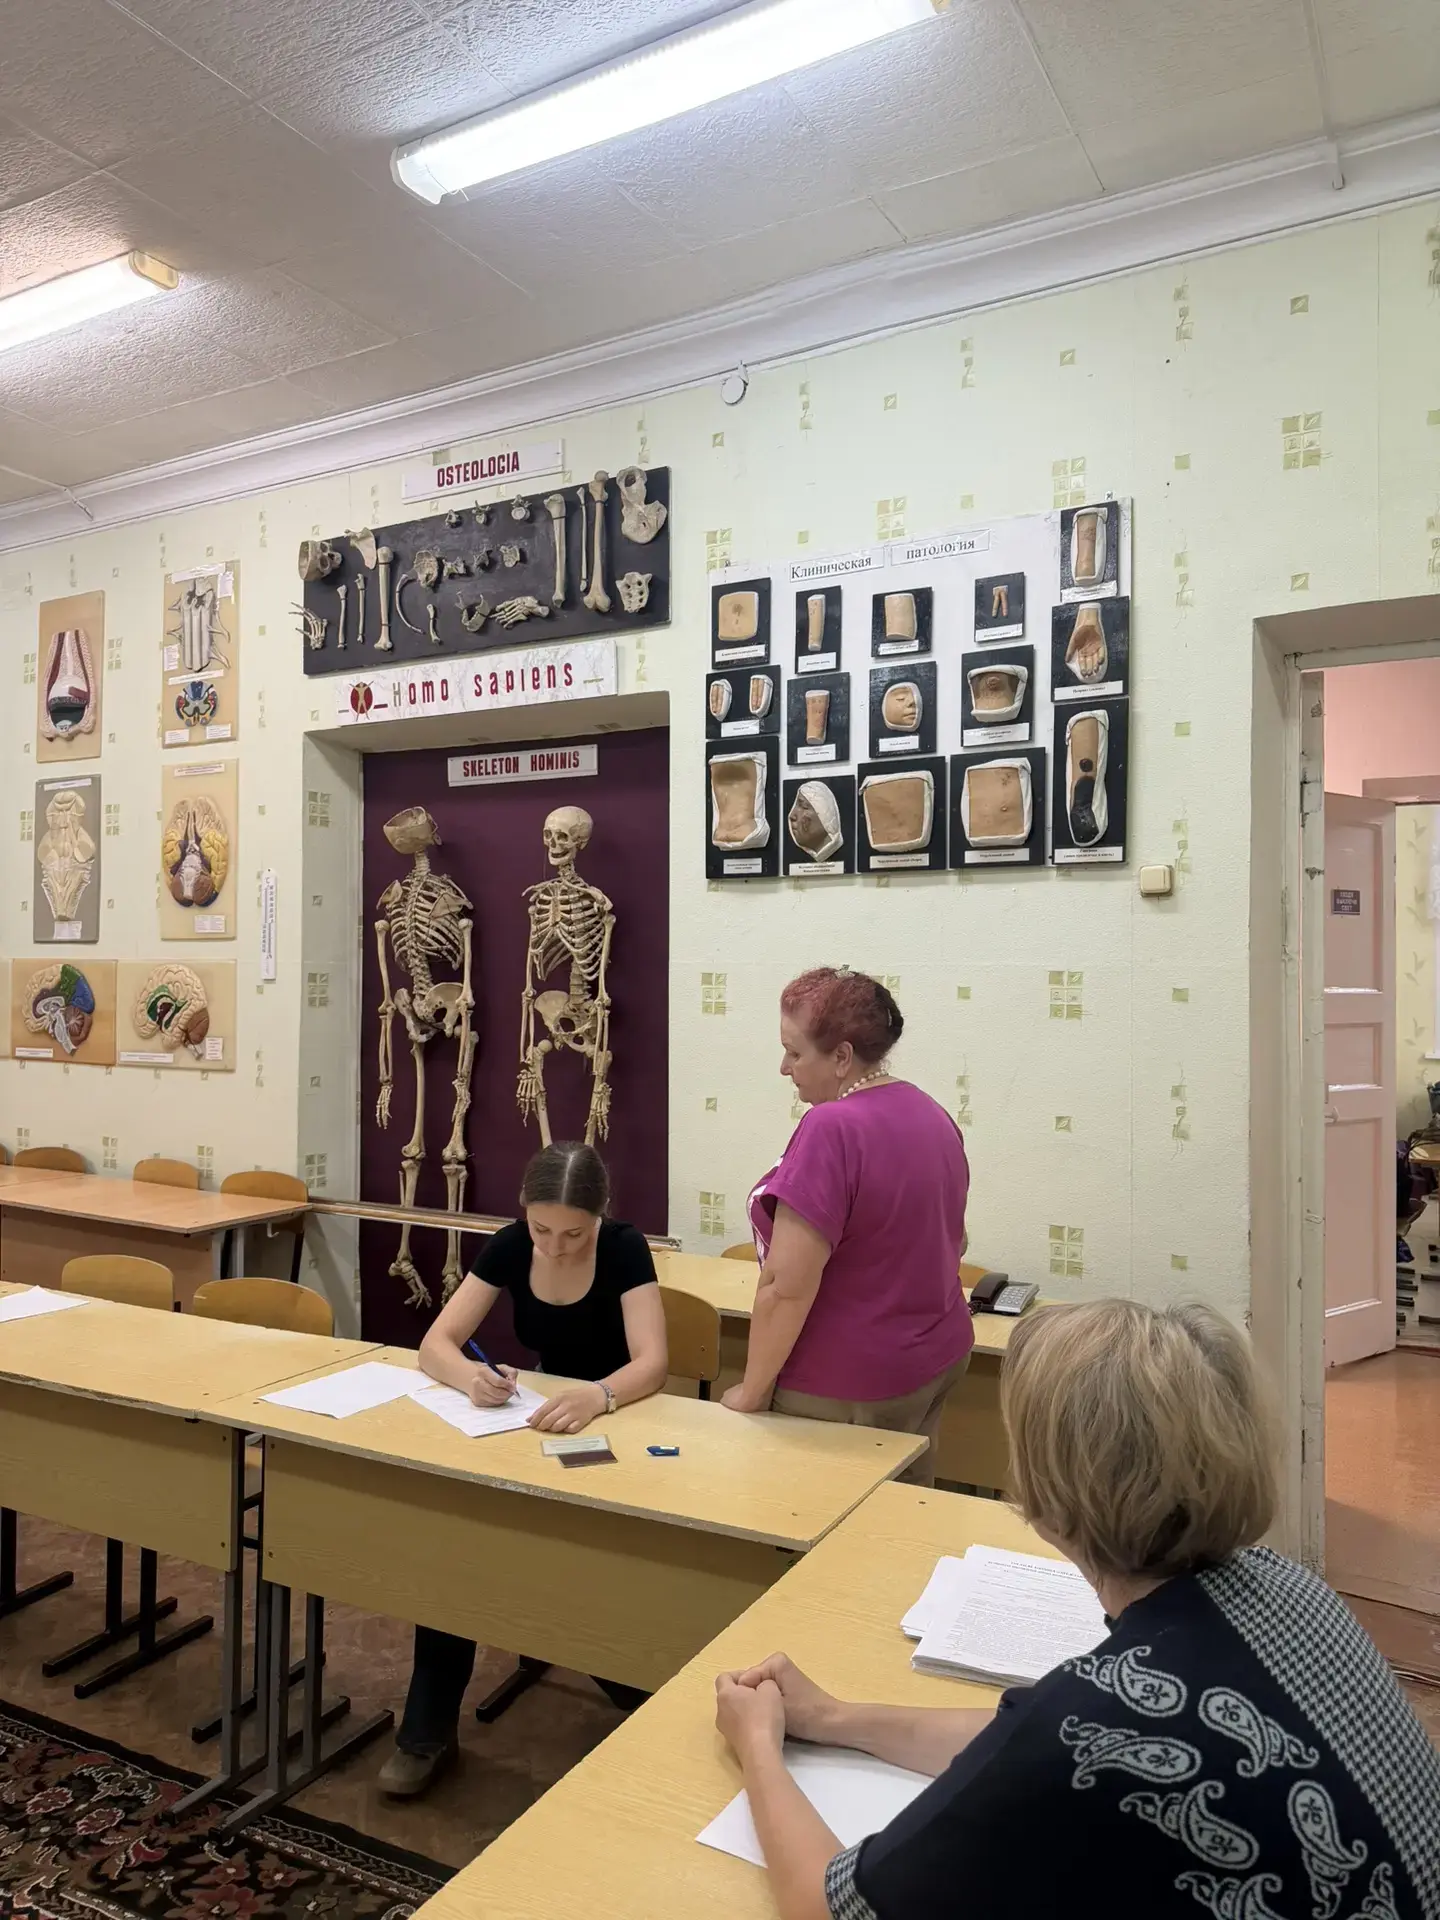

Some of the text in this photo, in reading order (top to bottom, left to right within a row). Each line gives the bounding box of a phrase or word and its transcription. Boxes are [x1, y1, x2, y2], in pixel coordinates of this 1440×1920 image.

[437, 451, 520, 488] OSTEOLOGIA
[791, 539, 975, 579] Клиническая патология
[392, 663, 573, 707] Homo sapiens
[463, 751, 580, 777] SKELETON HOMINIS
